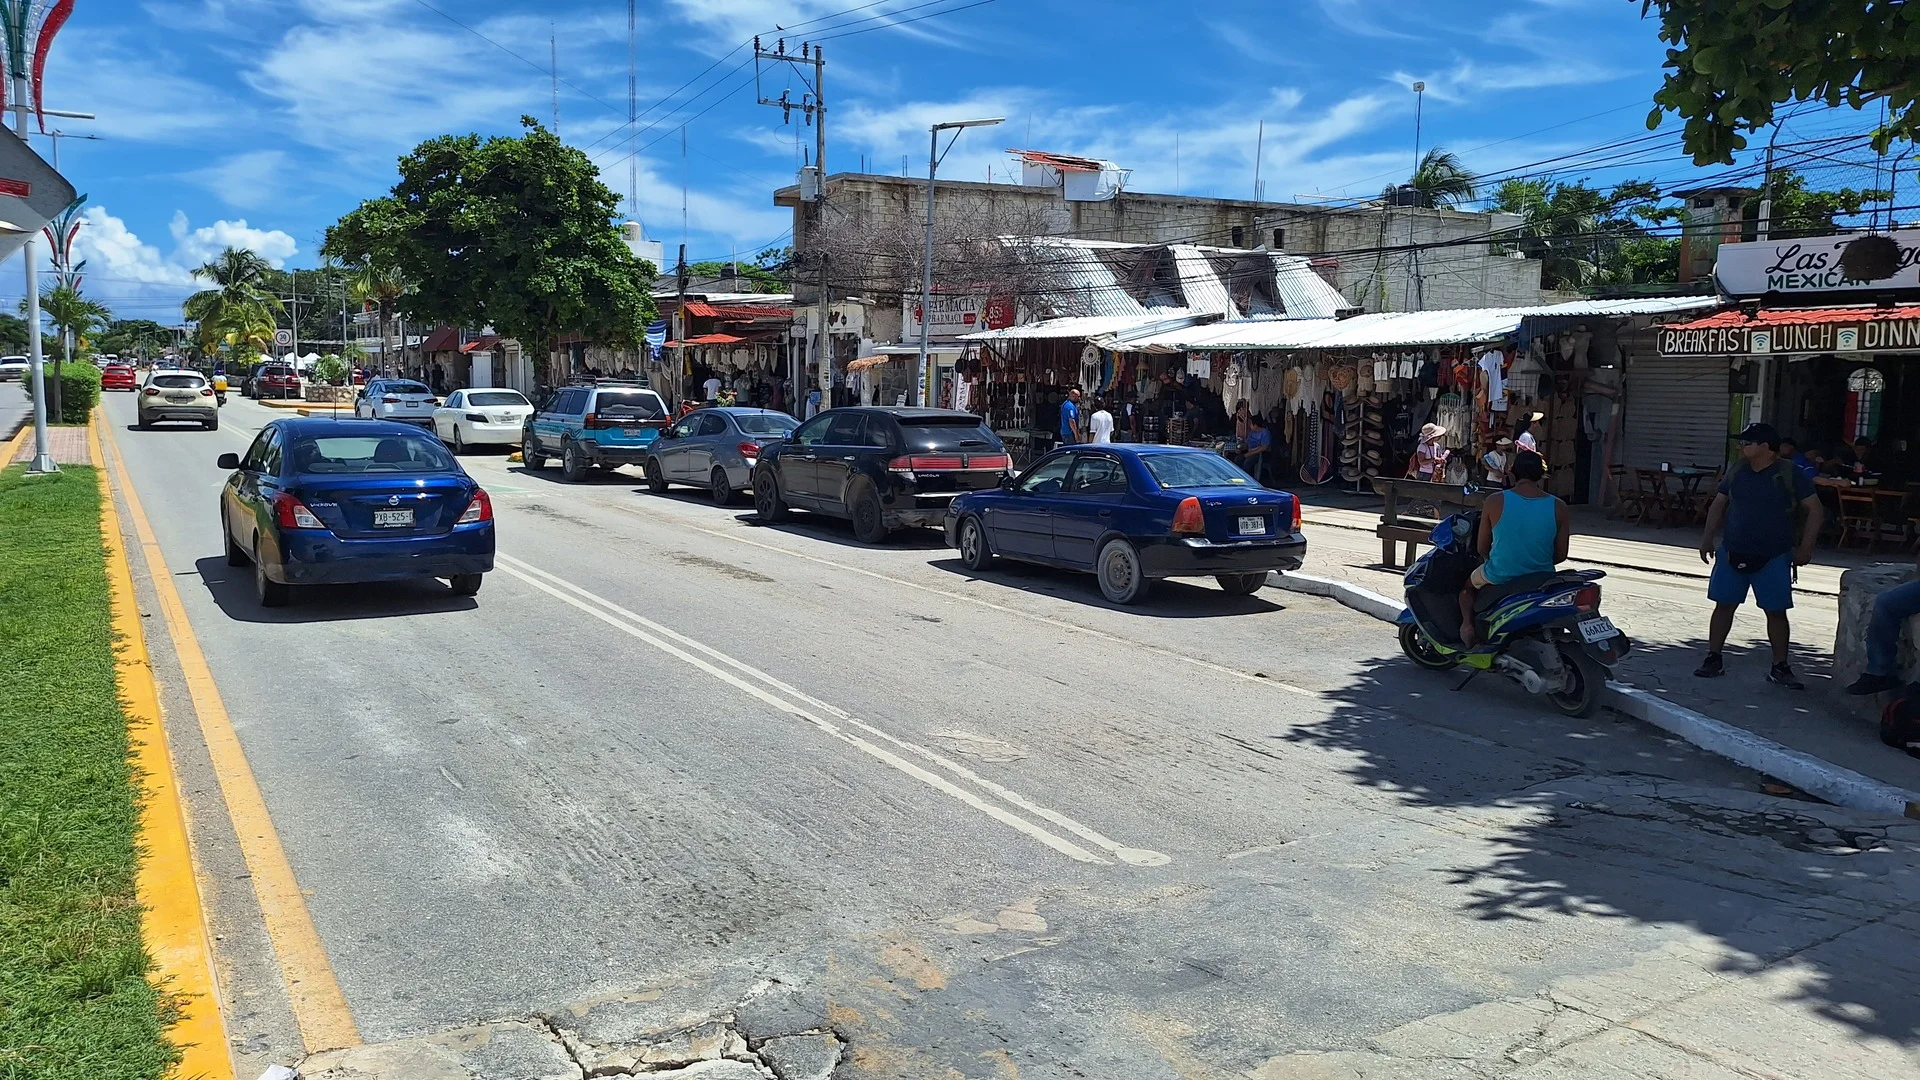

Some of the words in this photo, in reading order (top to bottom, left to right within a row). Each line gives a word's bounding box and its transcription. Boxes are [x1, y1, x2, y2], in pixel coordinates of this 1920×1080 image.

[1765, 243, 1829, 274] Las
[928, 298, 976, 313] FARMACIA
[1665, 327, 1752, 354] BREAKFAST
[1772, 324, 1833, 351] LUNCH
[1584, 621, 1613, 637] 66AZE6
